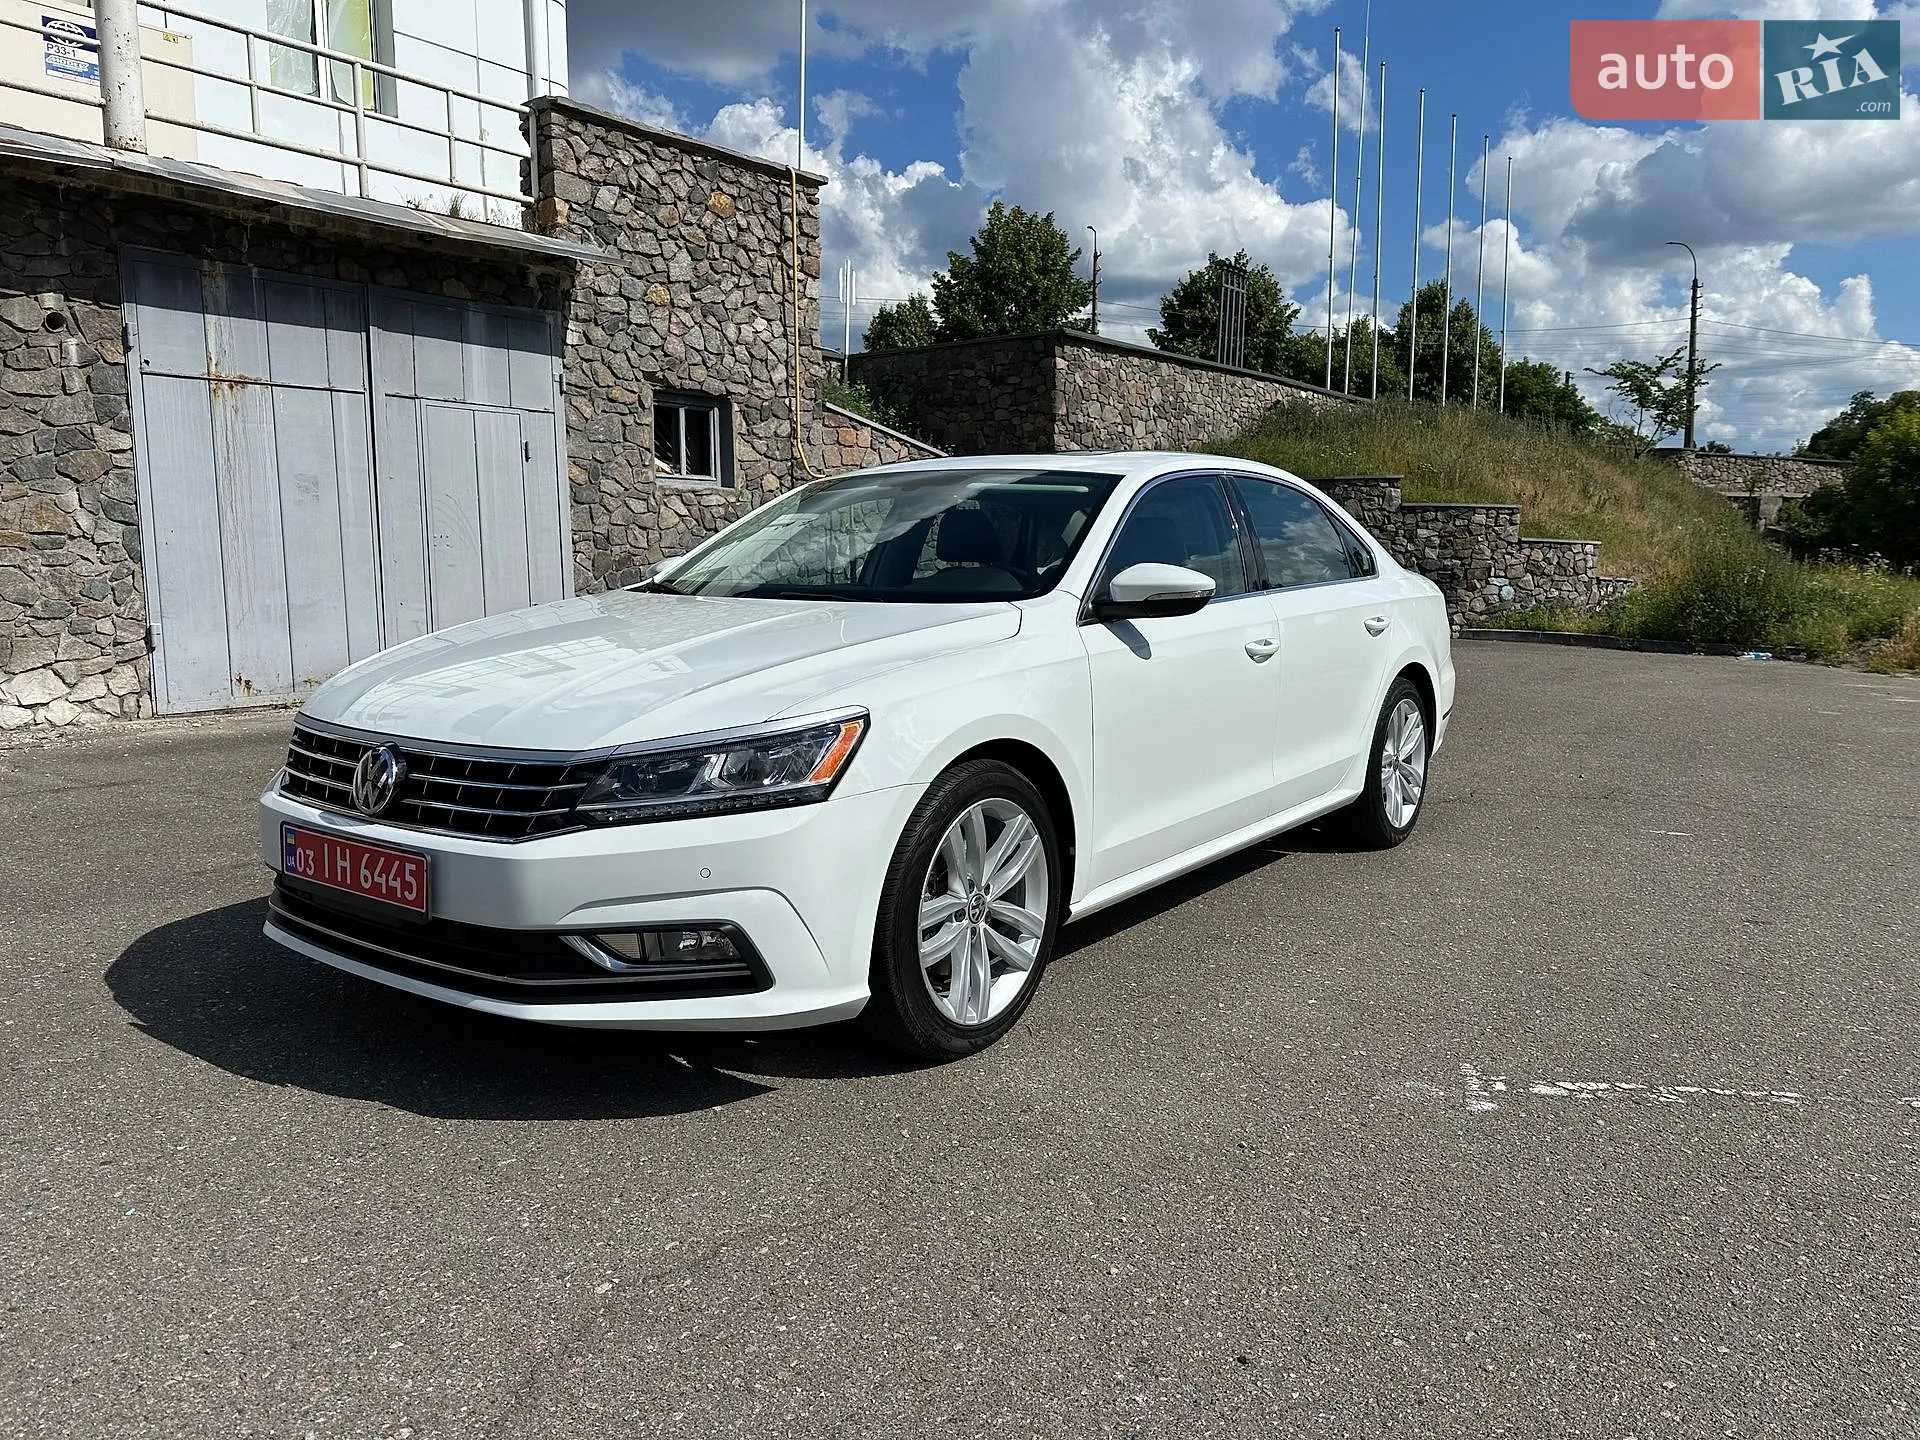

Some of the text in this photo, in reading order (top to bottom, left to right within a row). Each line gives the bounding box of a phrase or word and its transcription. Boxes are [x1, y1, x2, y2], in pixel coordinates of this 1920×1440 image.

[46, 42, 76, 57] P33-1
[287, 855, 295, 868] UA
[296, 847, 315, 876] 03
[360, 853, 417, 901] 6445
